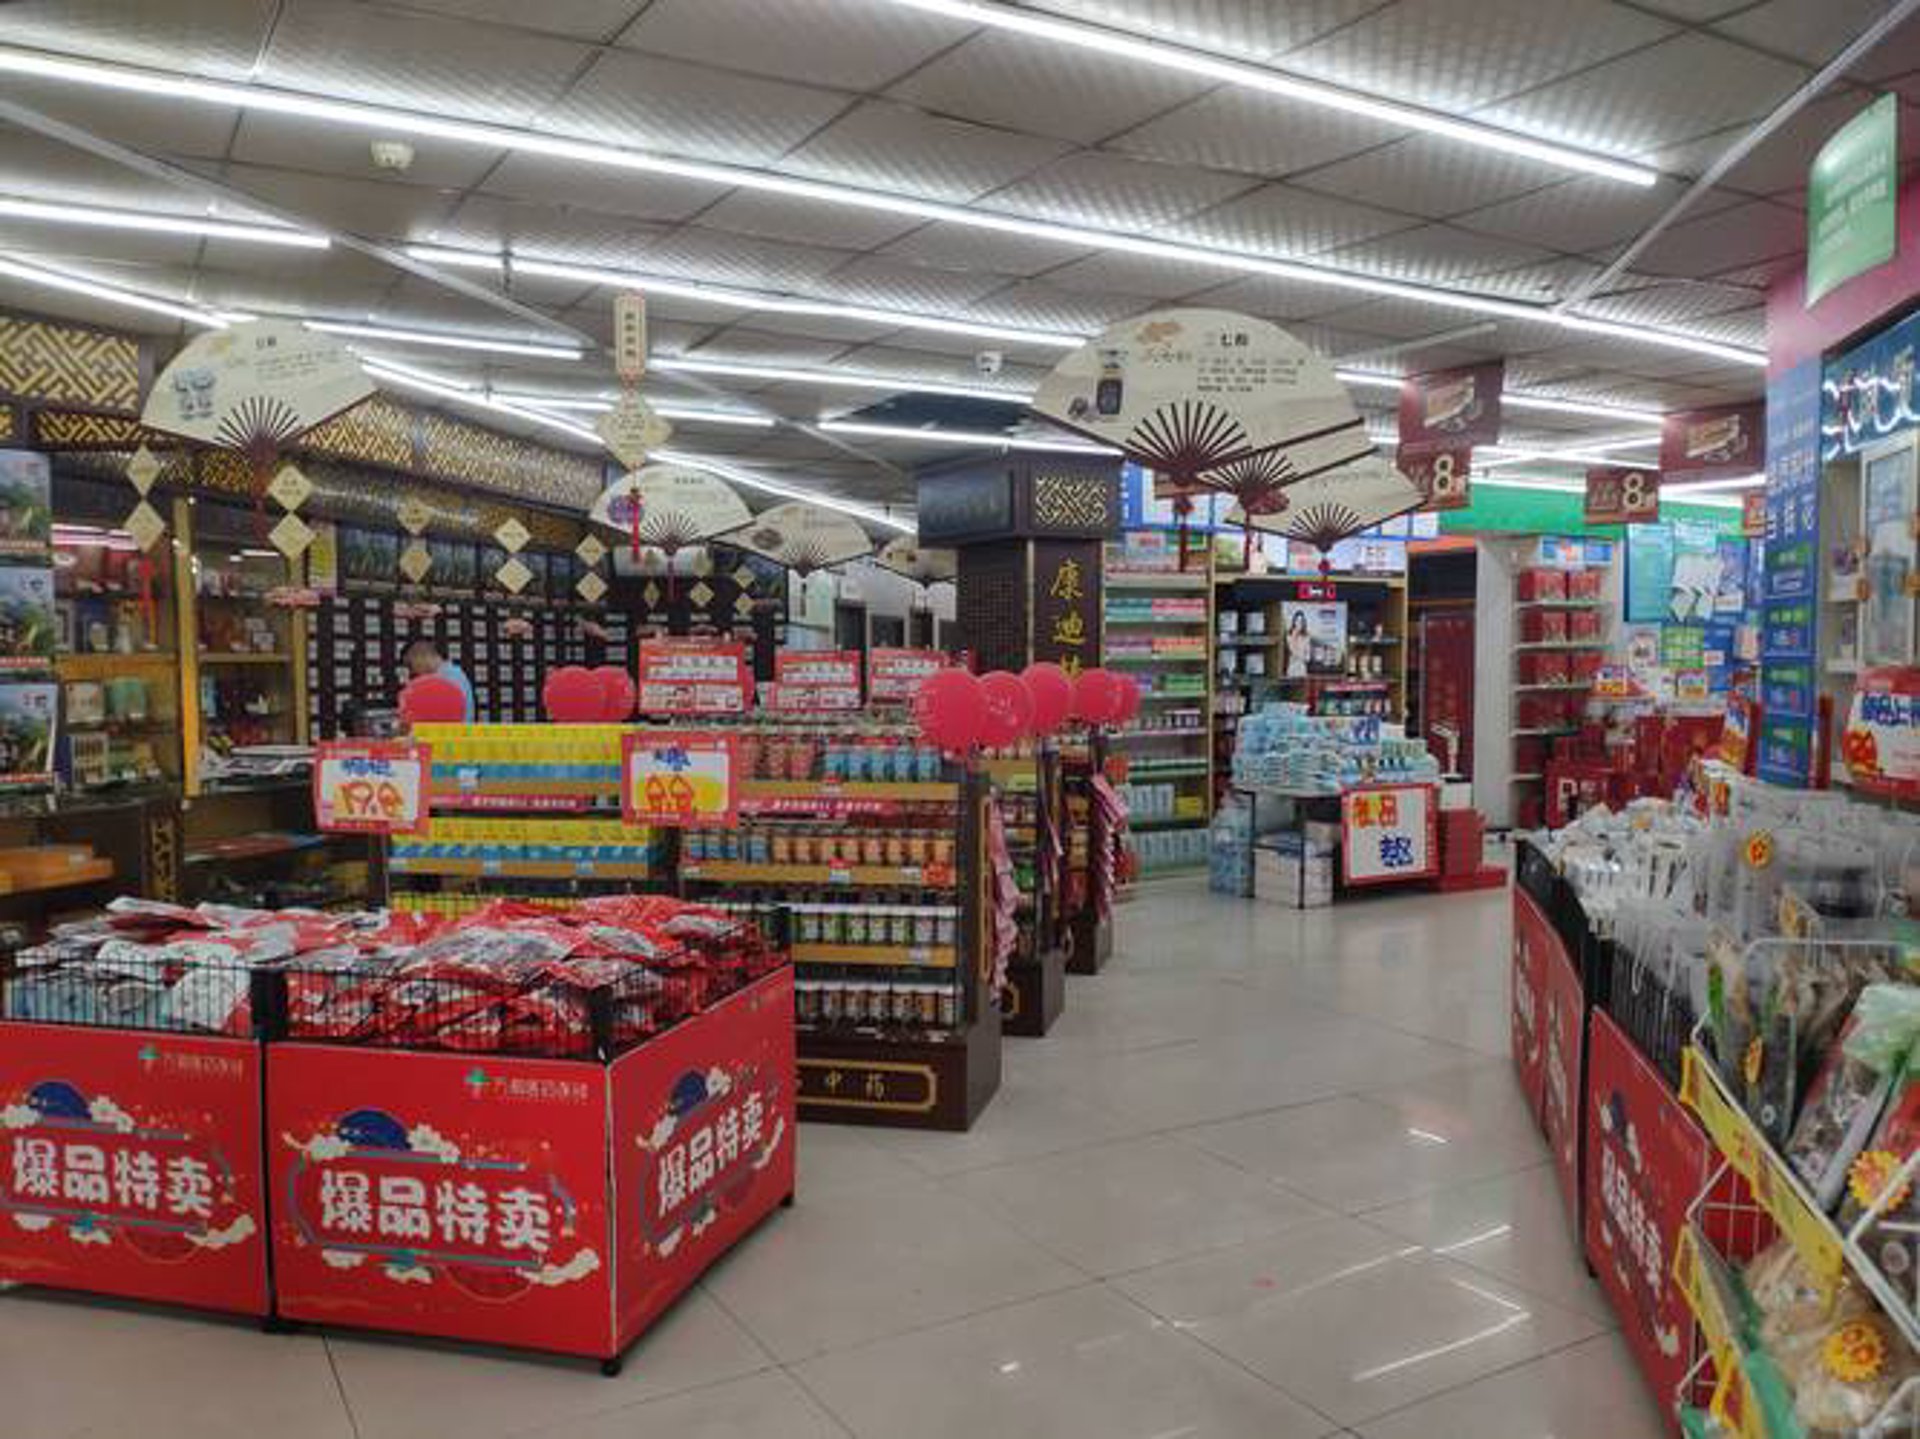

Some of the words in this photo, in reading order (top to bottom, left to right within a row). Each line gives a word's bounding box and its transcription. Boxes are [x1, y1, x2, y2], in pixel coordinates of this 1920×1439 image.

[14, 1137, 213, 1218] 爆品特卖
[659, 1092, 763, 1217] 爆品特卖
[320, 1169, 550, 1252] 爆品特卖
